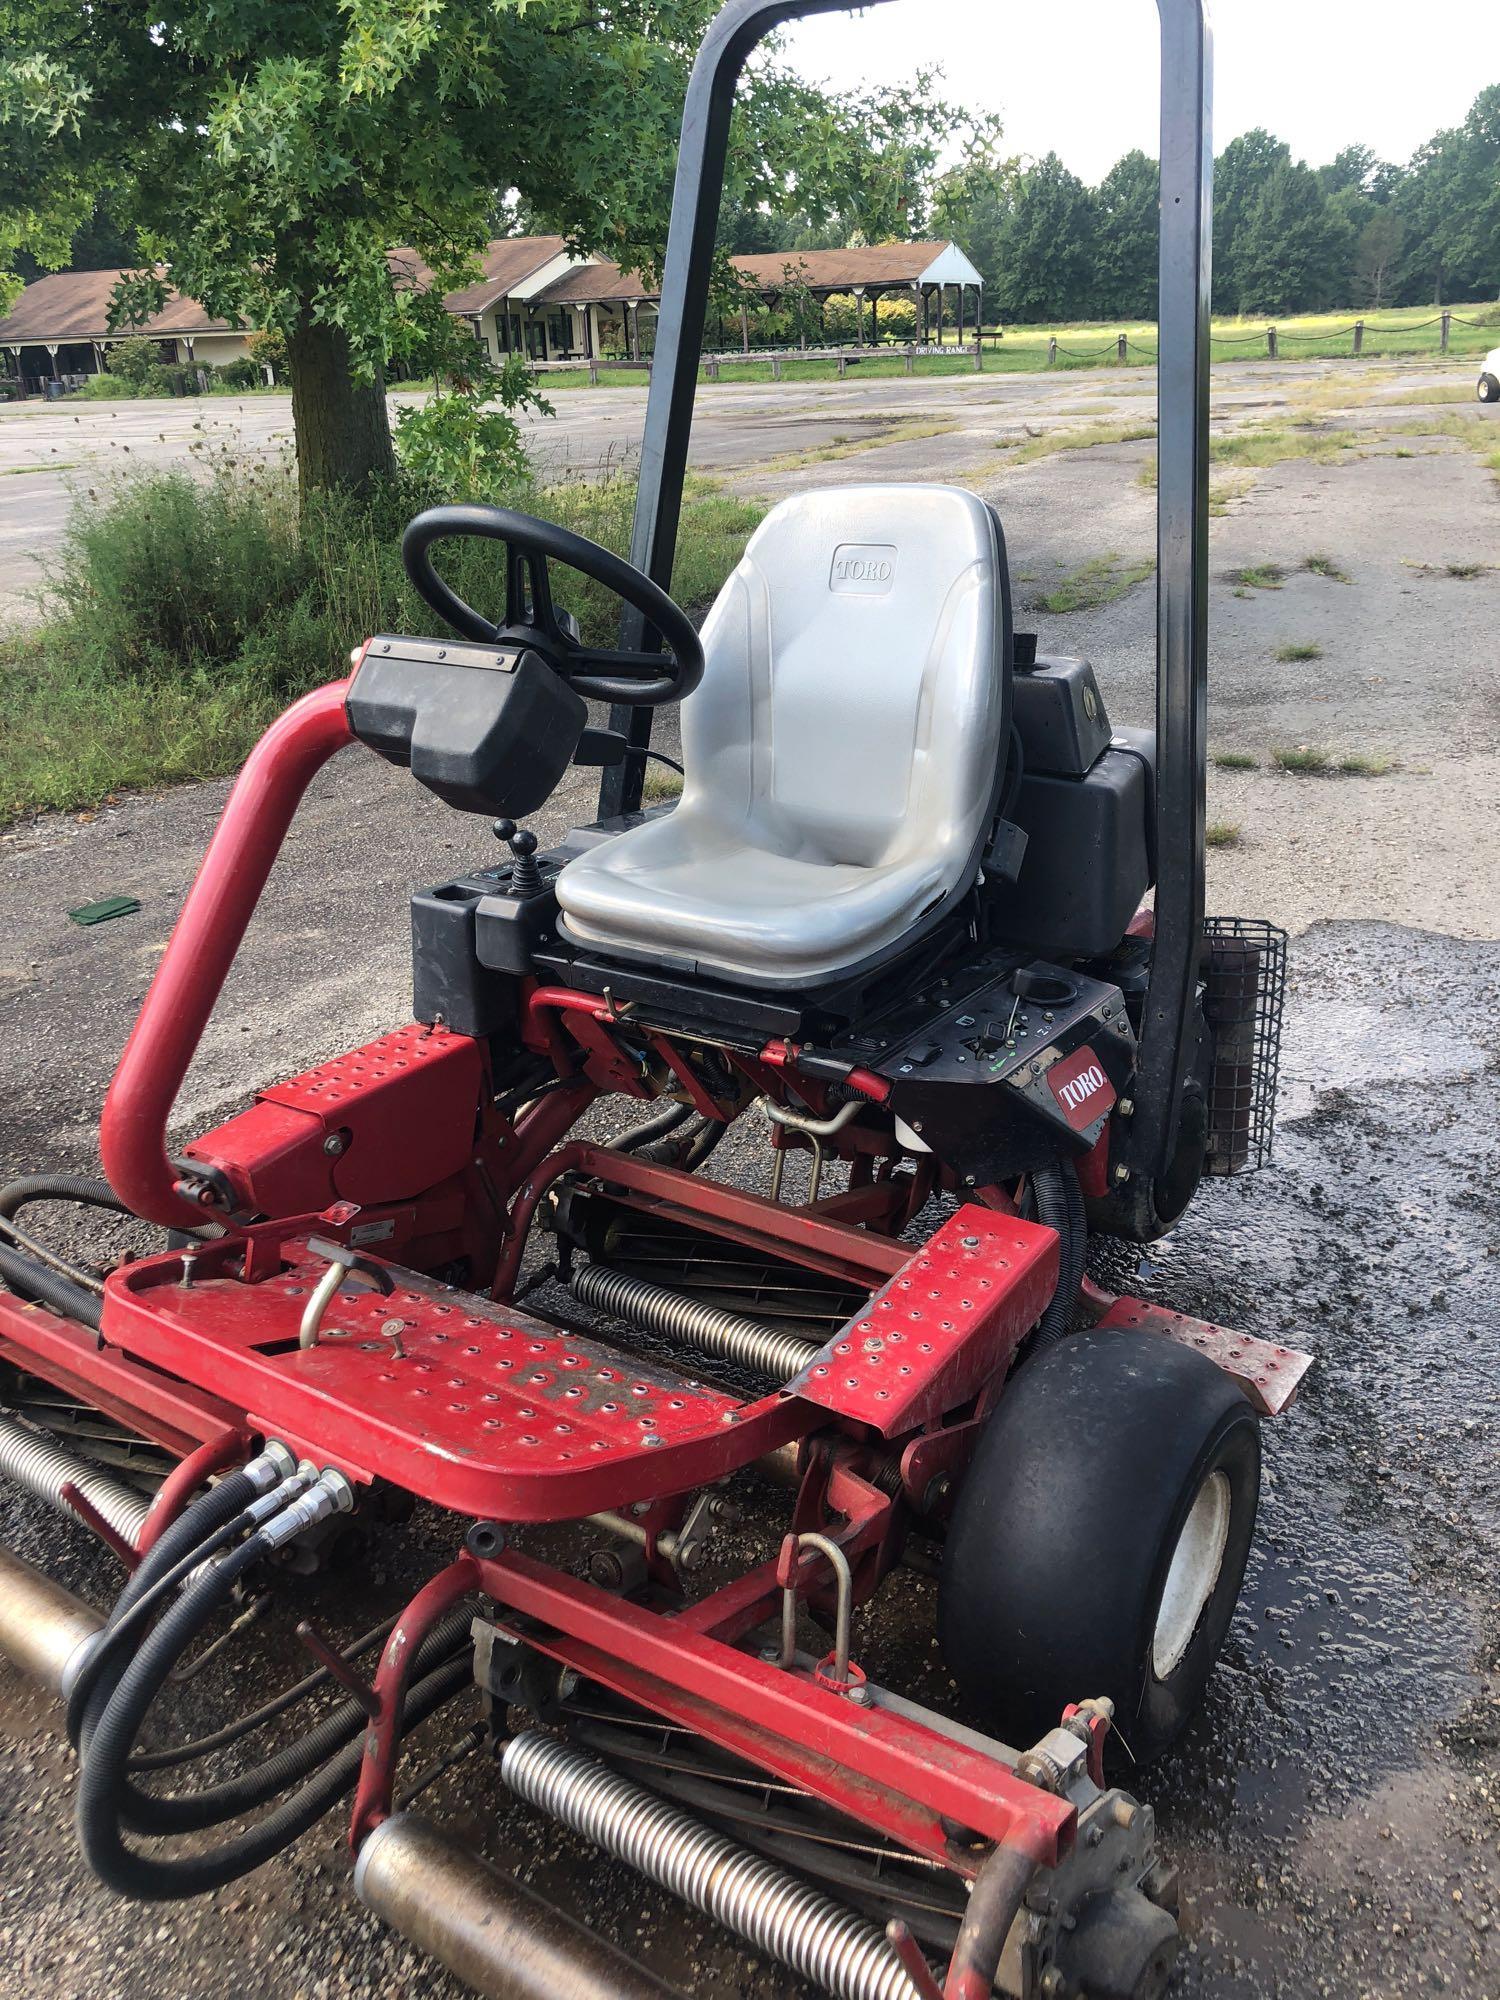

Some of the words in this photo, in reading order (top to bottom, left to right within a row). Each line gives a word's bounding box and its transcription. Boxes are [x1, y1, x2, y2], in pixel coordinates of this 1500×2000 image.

[916, 346, 944, 355] DRIVING
[946, 346, 968, 355] RANGE
[836, 560, 892, 581] TORO
[1058, 1065, 1104, 1111] TORO
